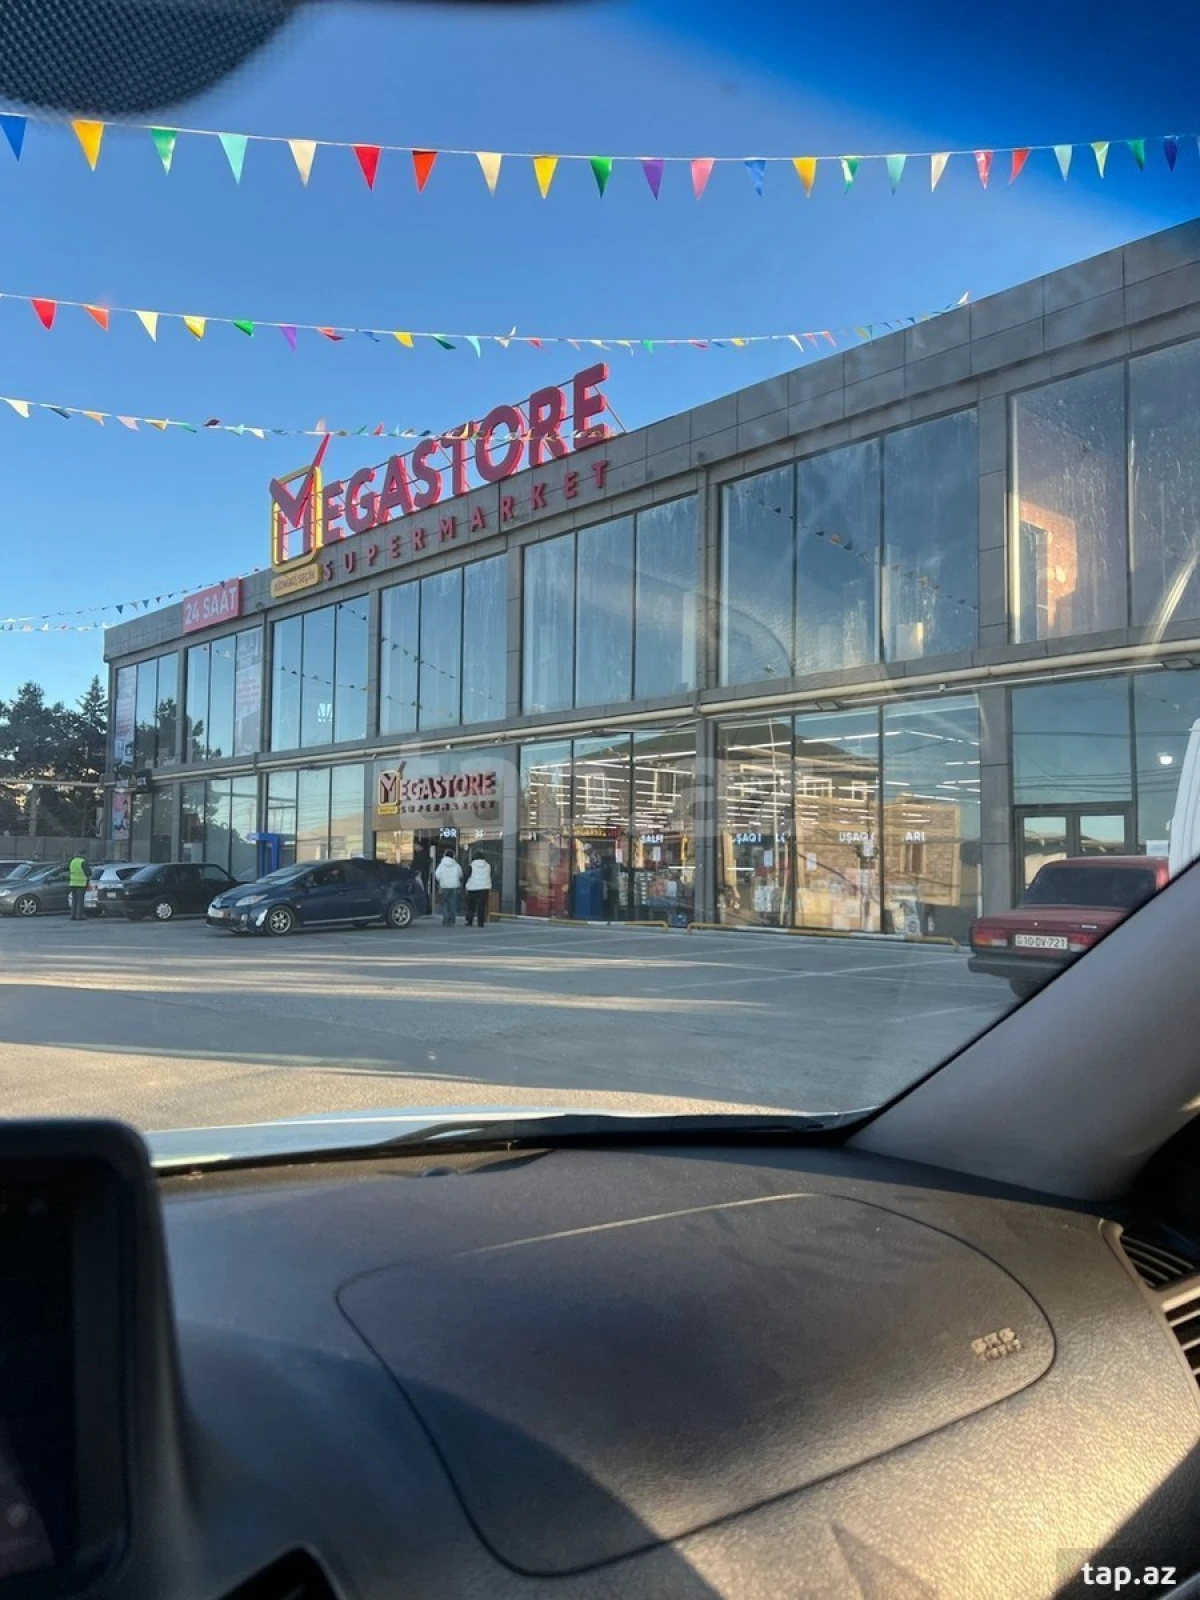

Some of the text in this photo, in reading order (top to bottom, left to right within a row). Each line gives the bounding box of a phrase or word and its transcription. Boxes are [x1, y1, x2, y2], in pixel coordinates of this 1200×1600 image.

[269, 362, 609, 564] MEGASTORE
[323, 460, 609, 581] SUPERMARKET
[185, 587, 237, 625] 24 SAAT
[380, 761, 497, 803] MEGASTORE
